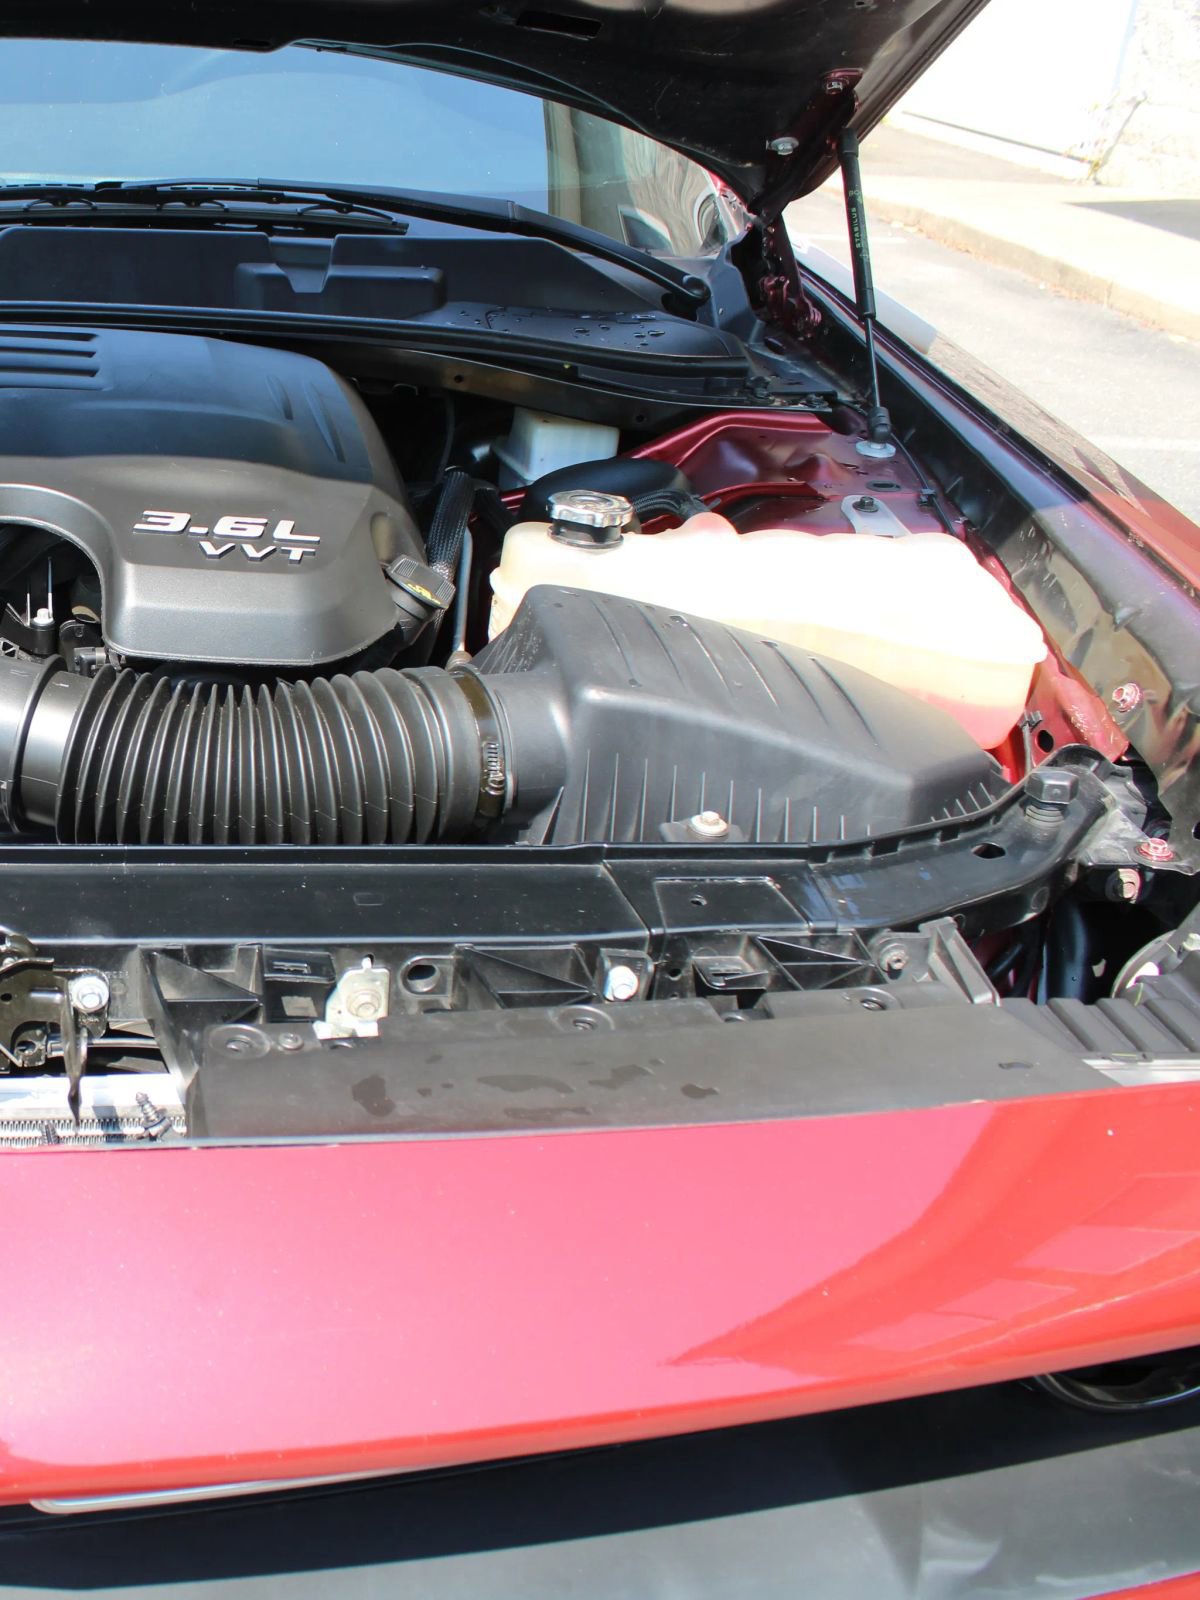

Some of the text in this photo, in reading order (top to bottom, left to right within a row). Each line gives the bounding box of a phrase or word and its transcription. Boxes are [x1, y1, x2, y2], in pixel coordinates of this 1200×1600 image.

[851, 207, 861, 248] STABILUS
[133, 510, 321, 543] 3.6L
[199, 541, 316, 565] VVT
